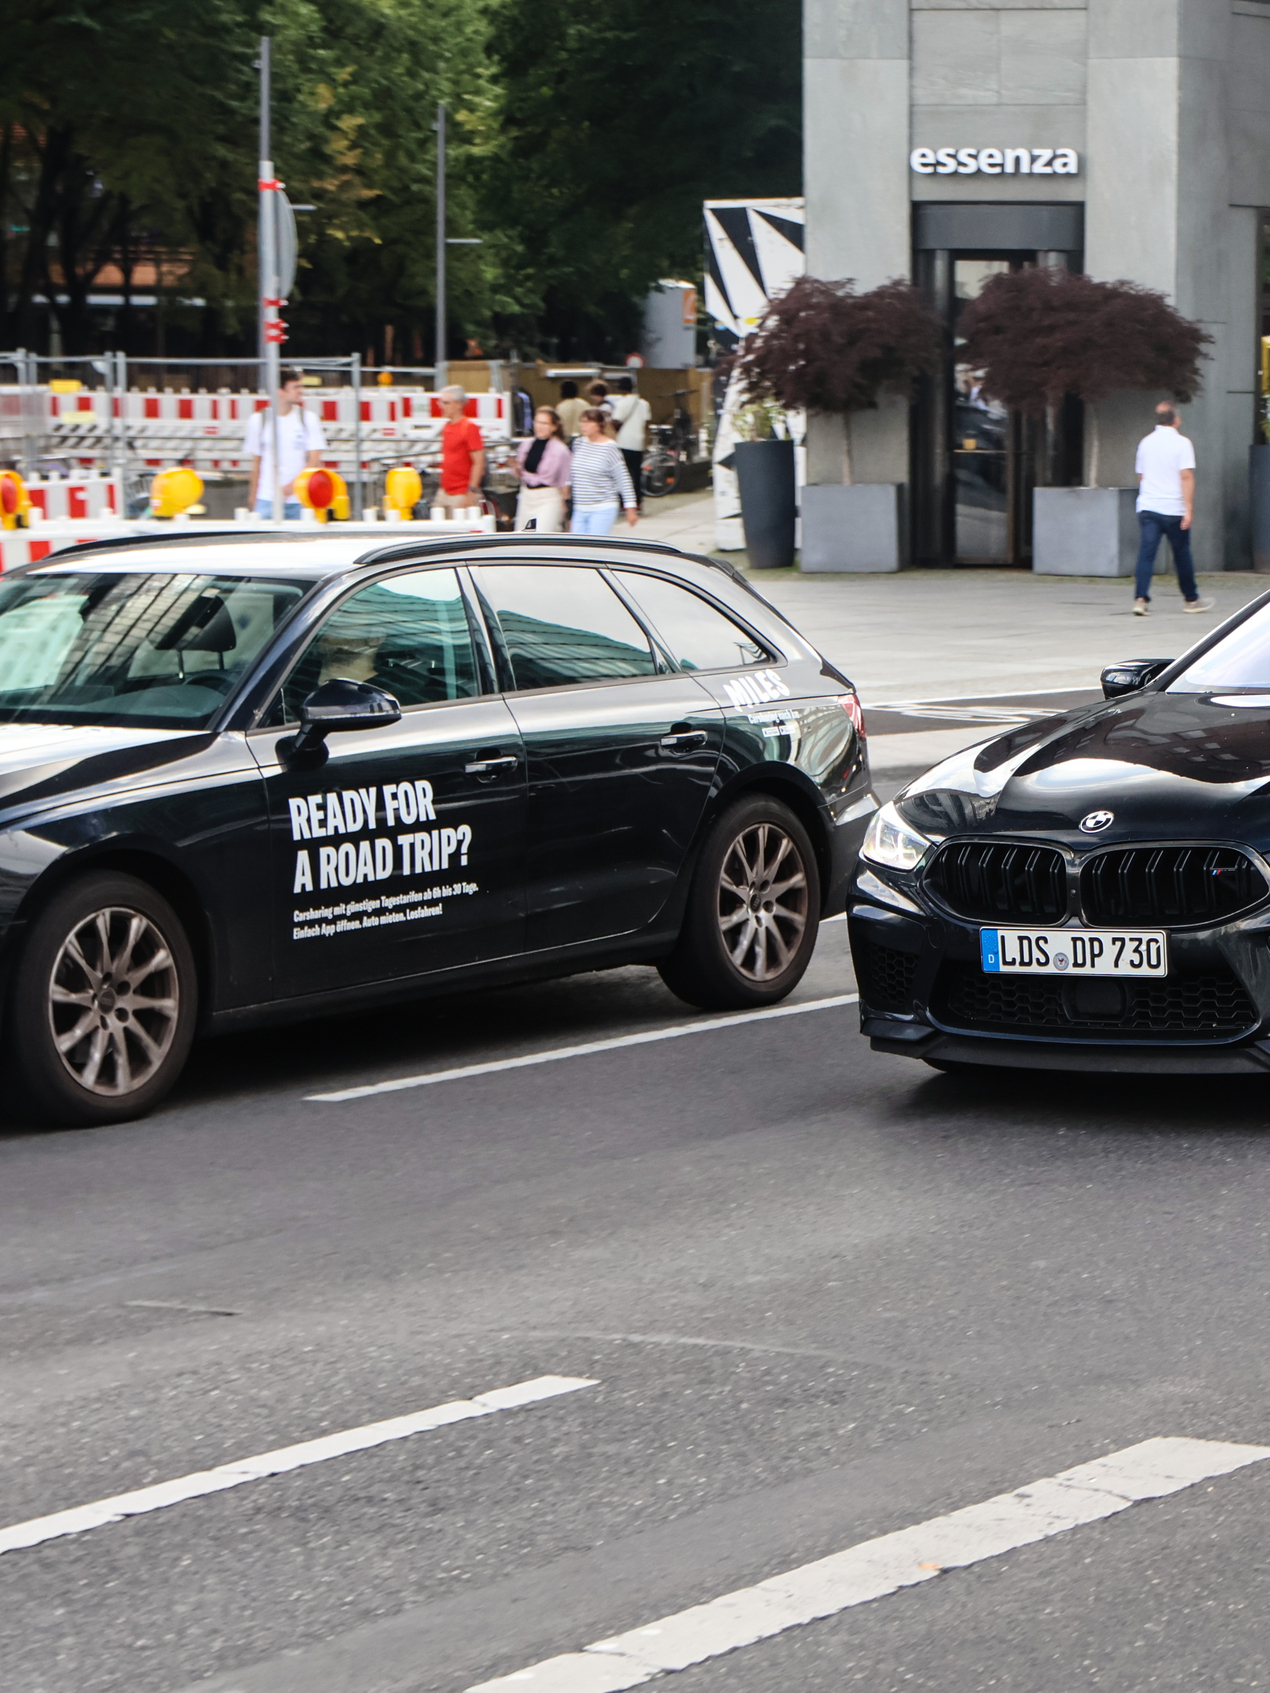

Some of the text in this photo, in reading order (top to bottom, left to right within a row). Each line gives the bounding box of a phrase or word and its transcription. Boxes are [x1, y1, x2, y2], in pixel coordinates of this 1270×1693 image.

[910, 147, 1079, 174] essenza
[723, 669, 790, 712] MILES
[288, 780, 436, 841] READY FOR
[293, 824, 472, 893] A ROAD TRIP?
[293, 905, 333, 923] Carsharing
[333, 903, 346, 916] mit
[346, 898, 380, 916] günstigen
[380, 891, 423, 909] Tagestarifen
[423, 888, 432, 900] ab
[432, 886, 441, 898] 6h
[441, 885, 453, 897] bis
[453, 883, 462, 895] 30
[293, 903, 442, 940] Einfach App öffnen. Auto mieten. Losfahren!
[1000, 934, 1162, 969] LDS DP 730
